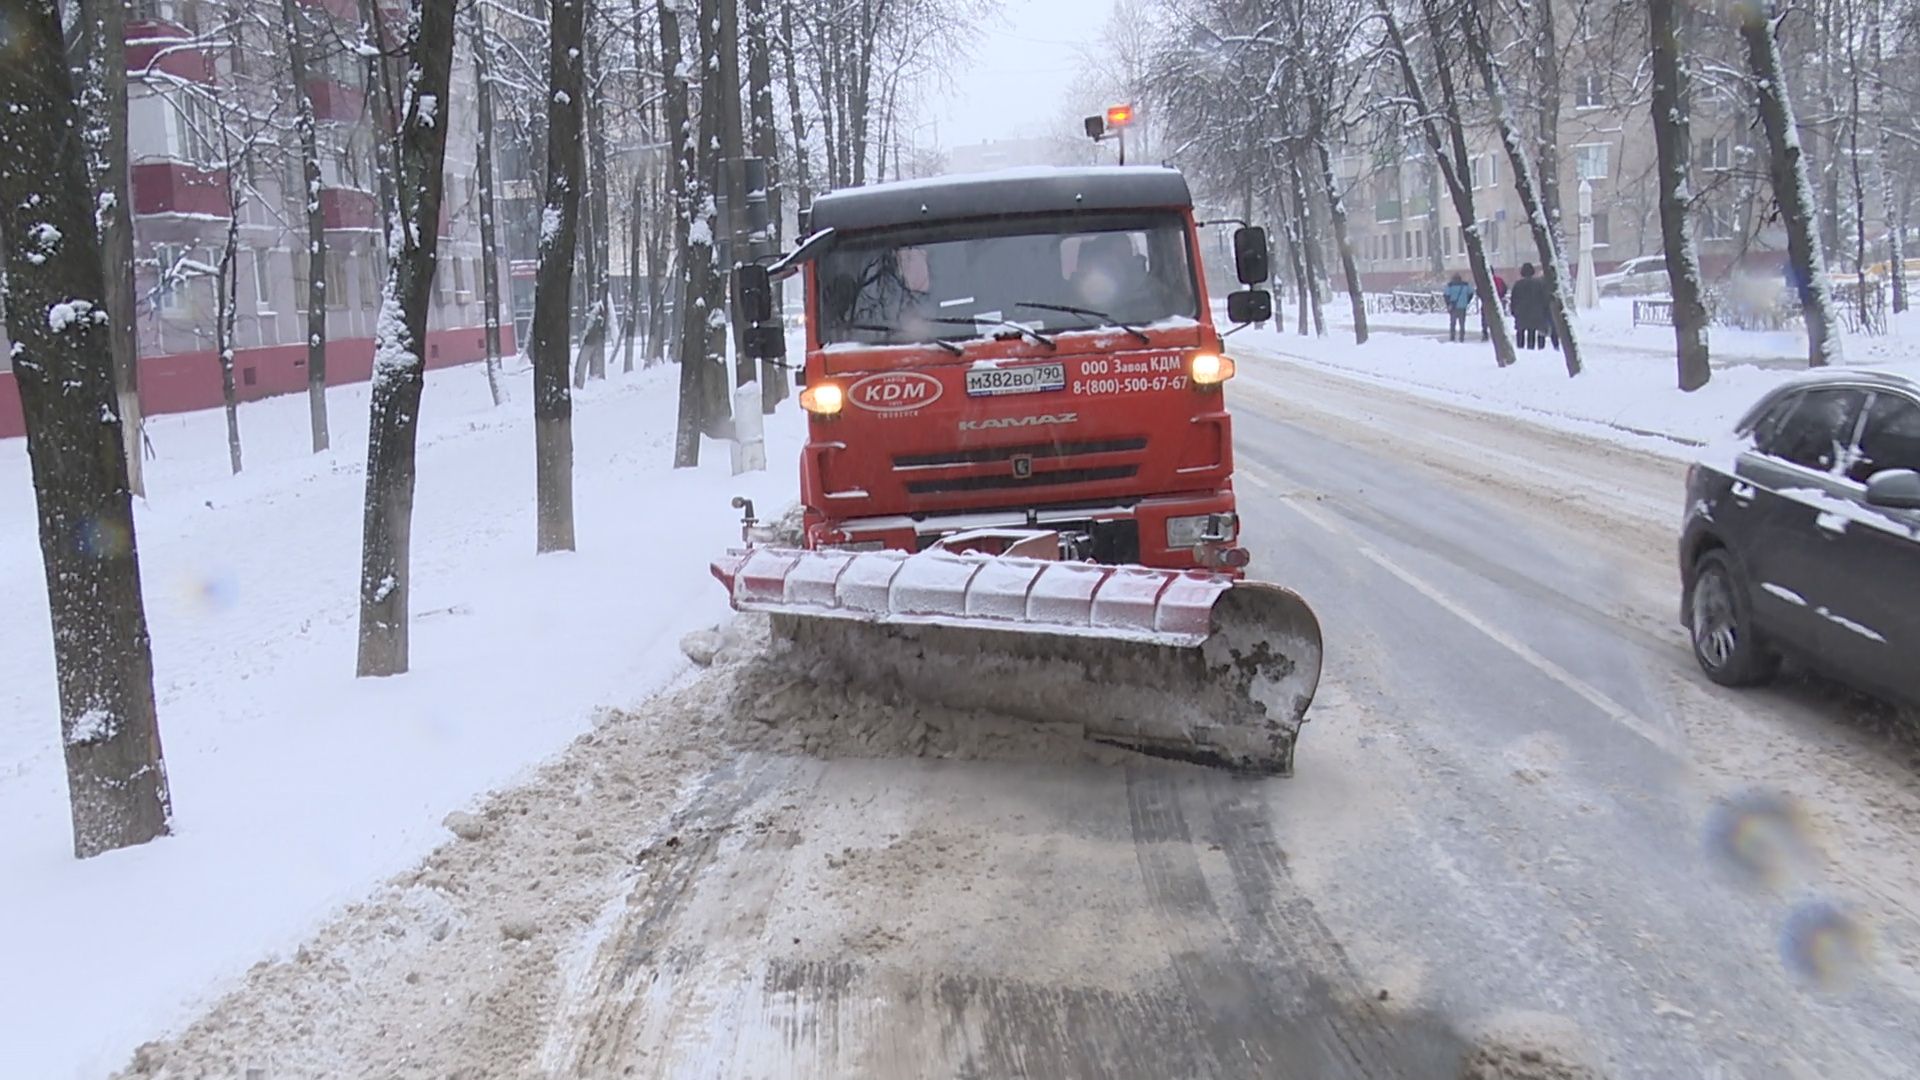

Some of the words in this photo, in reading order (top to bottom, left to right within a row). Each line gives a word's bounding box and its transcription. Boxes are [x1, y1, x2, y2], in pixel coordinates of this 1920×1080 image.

[1036, 366, 1060, 380] 790
[1081, 361, 1108, 375] ООО
[865, 382, 926, 401] KDM
[1073, 375, 1188, 395] 8-(800)-500-67-67
